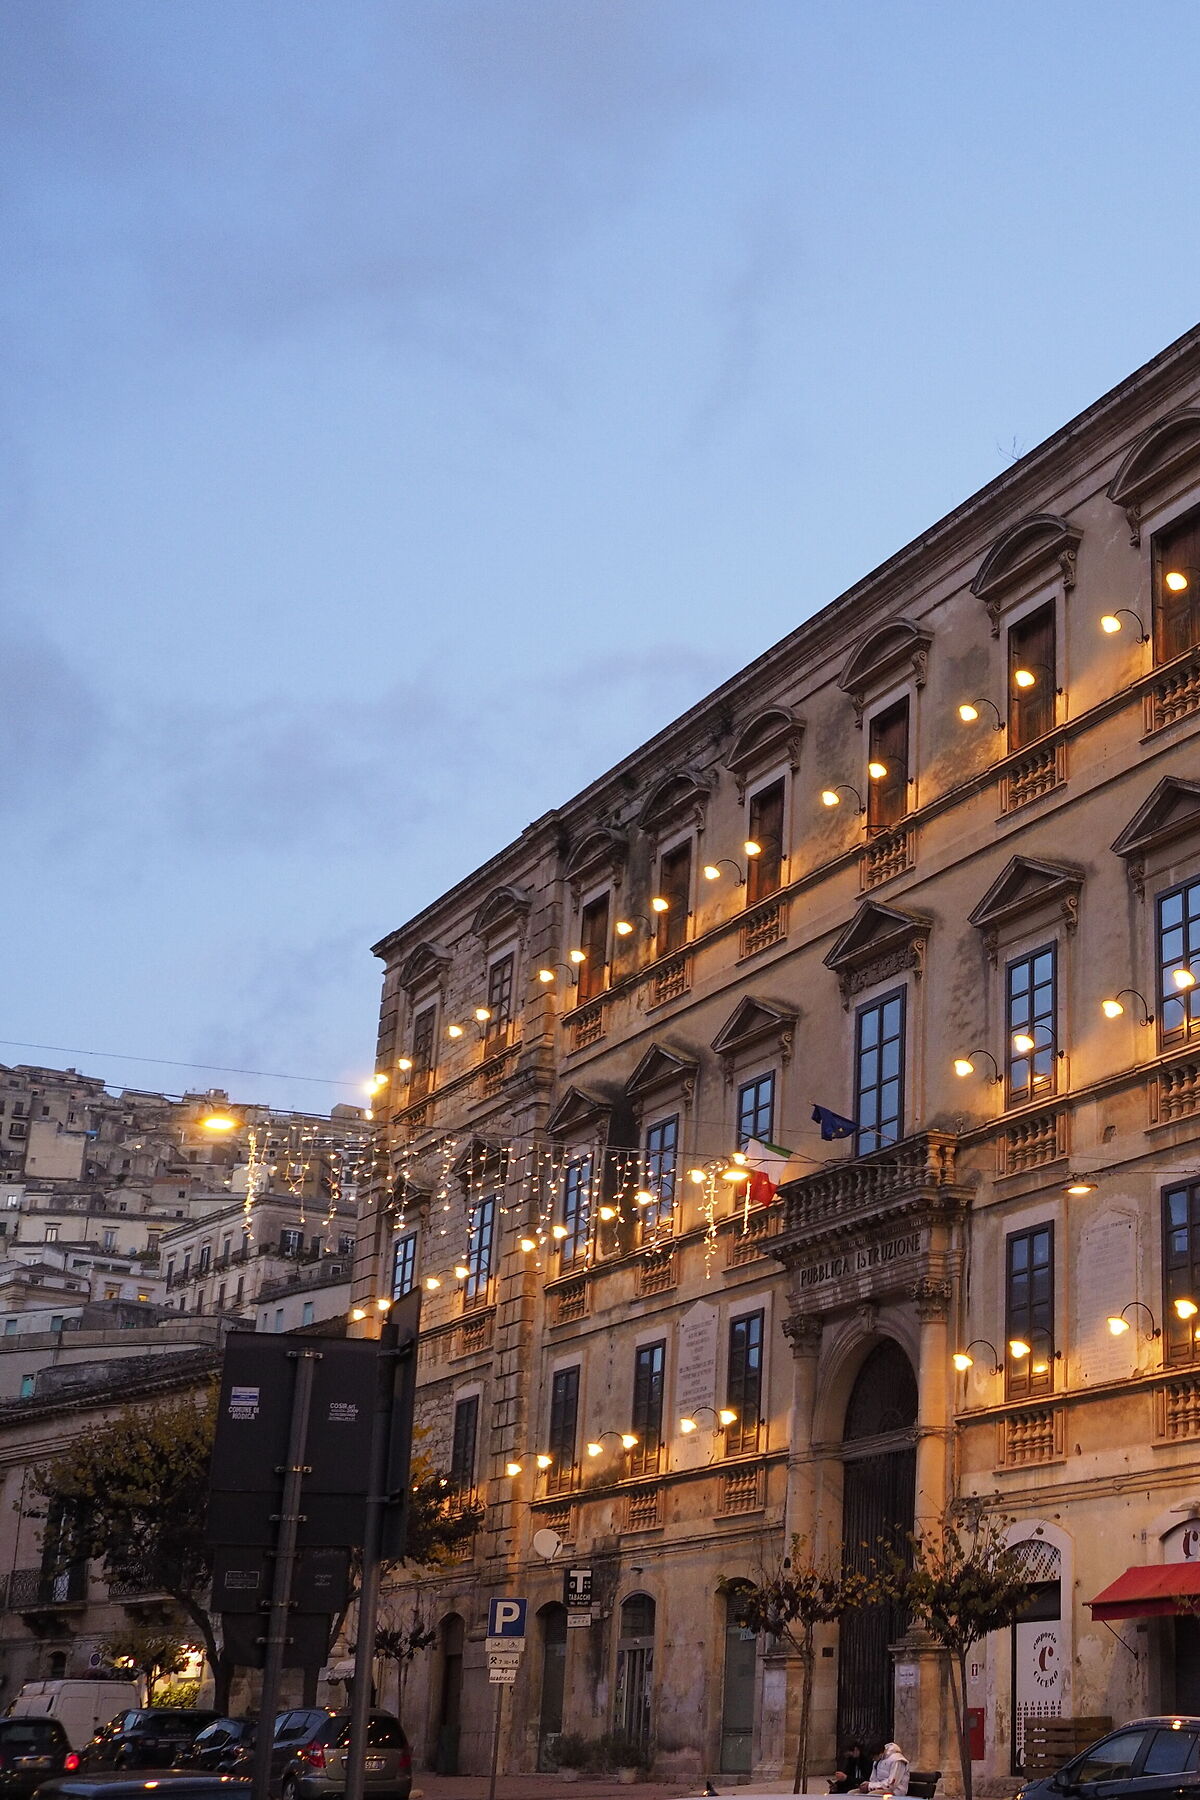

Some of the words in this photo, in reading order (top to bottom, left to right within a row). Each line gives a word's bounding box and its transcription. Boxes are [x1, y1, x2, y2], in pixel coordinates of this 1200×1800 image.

[801, 1259, 850, 1287] PUBBLICA
[857, 1233, 921, 1269] ISTRUZIONE
[494, 1601, 521, 1634] P
[1033, 1632, 1057, 1650] emporio
[1033, 1670, 1059, 1688] CICERO
